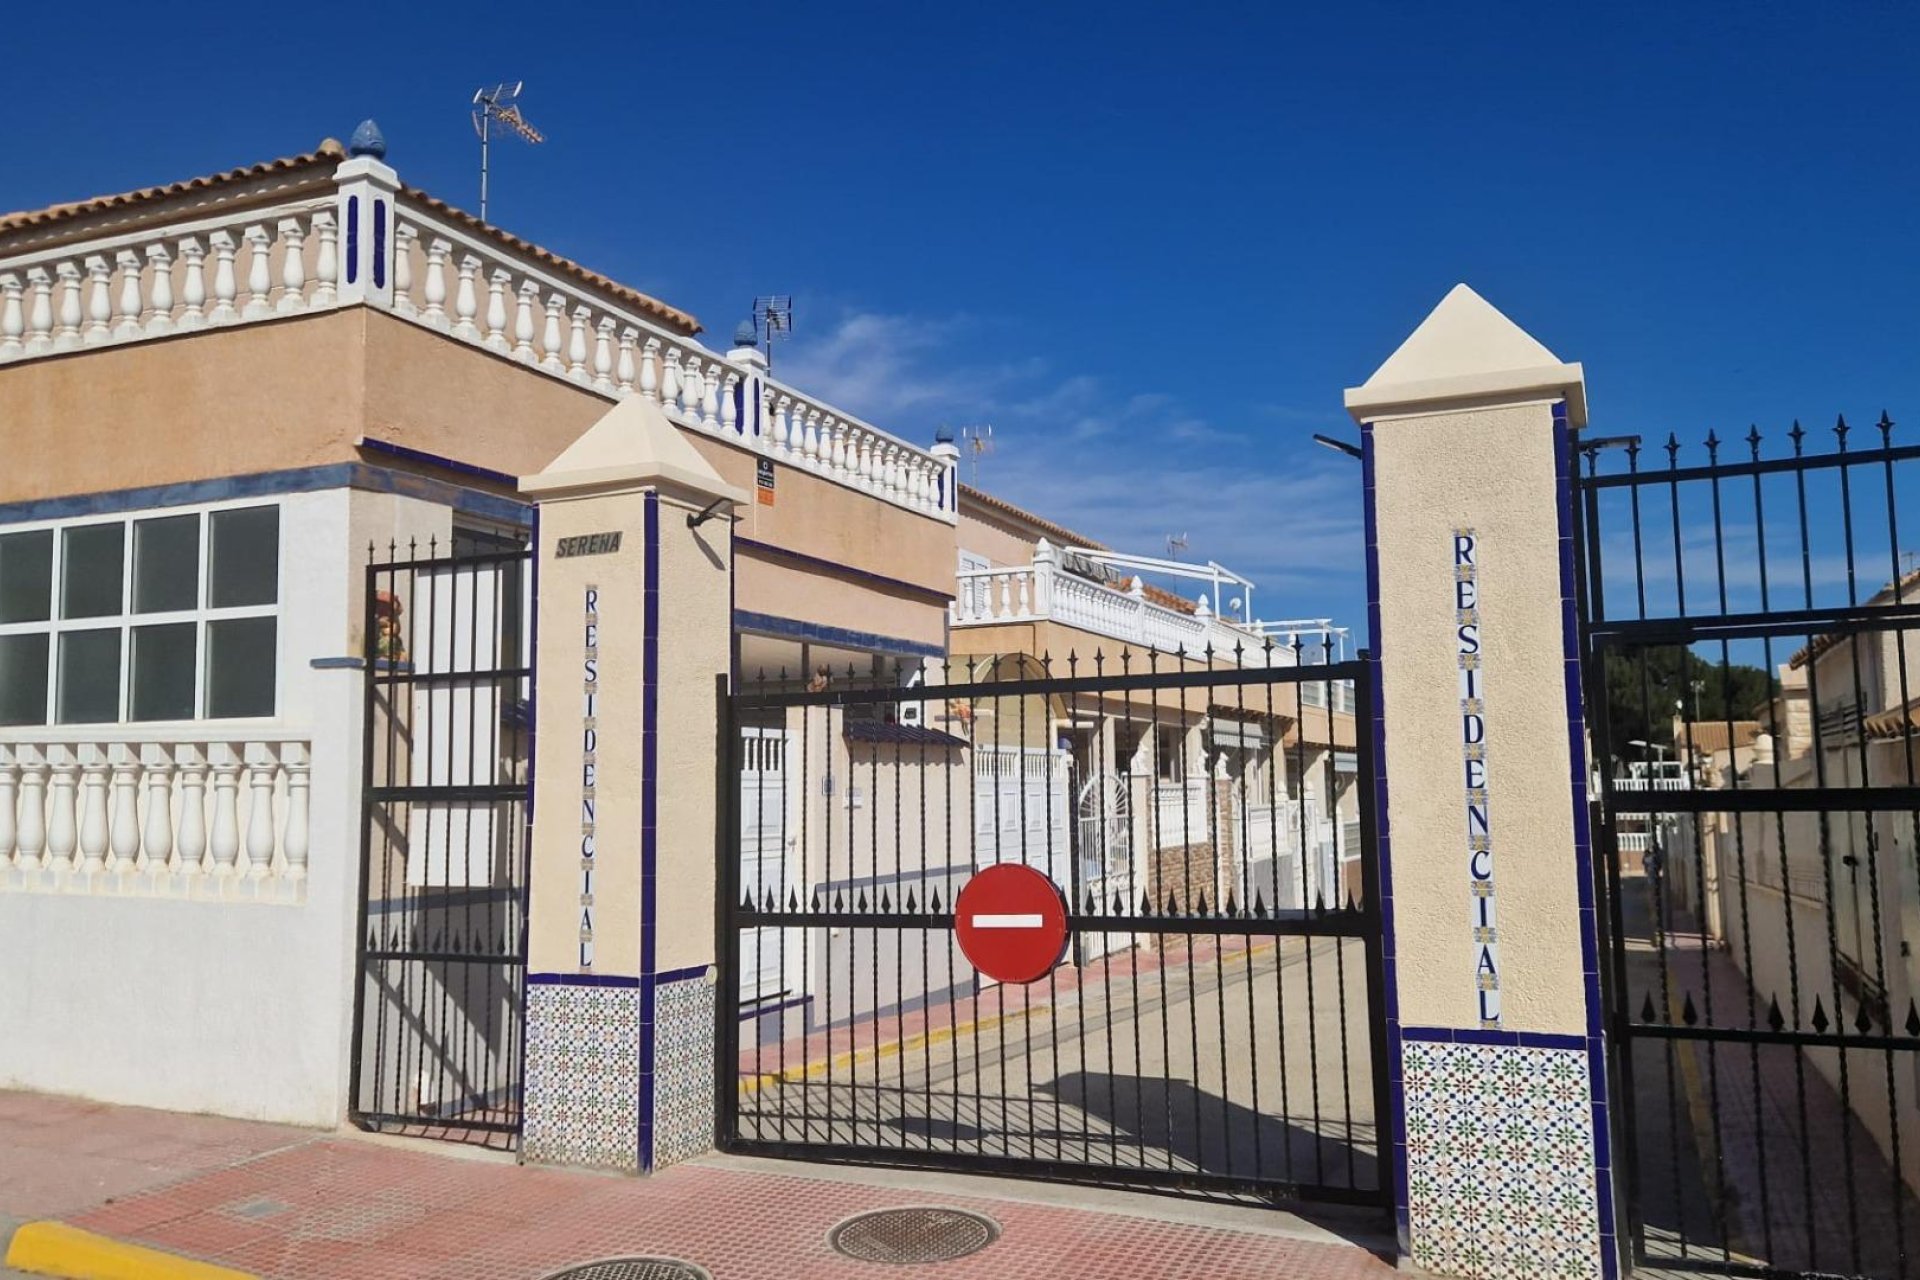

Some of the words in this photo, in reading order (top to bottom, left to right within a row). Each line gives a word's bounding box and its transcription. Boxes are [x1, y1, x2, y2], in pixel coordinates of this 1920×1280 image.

[556, 532, 621, 558] SERENA
[580, 588, 598, 967] RESIDENCIAL
[1454, 535, 1500, 1021] RESIDENCIAL
